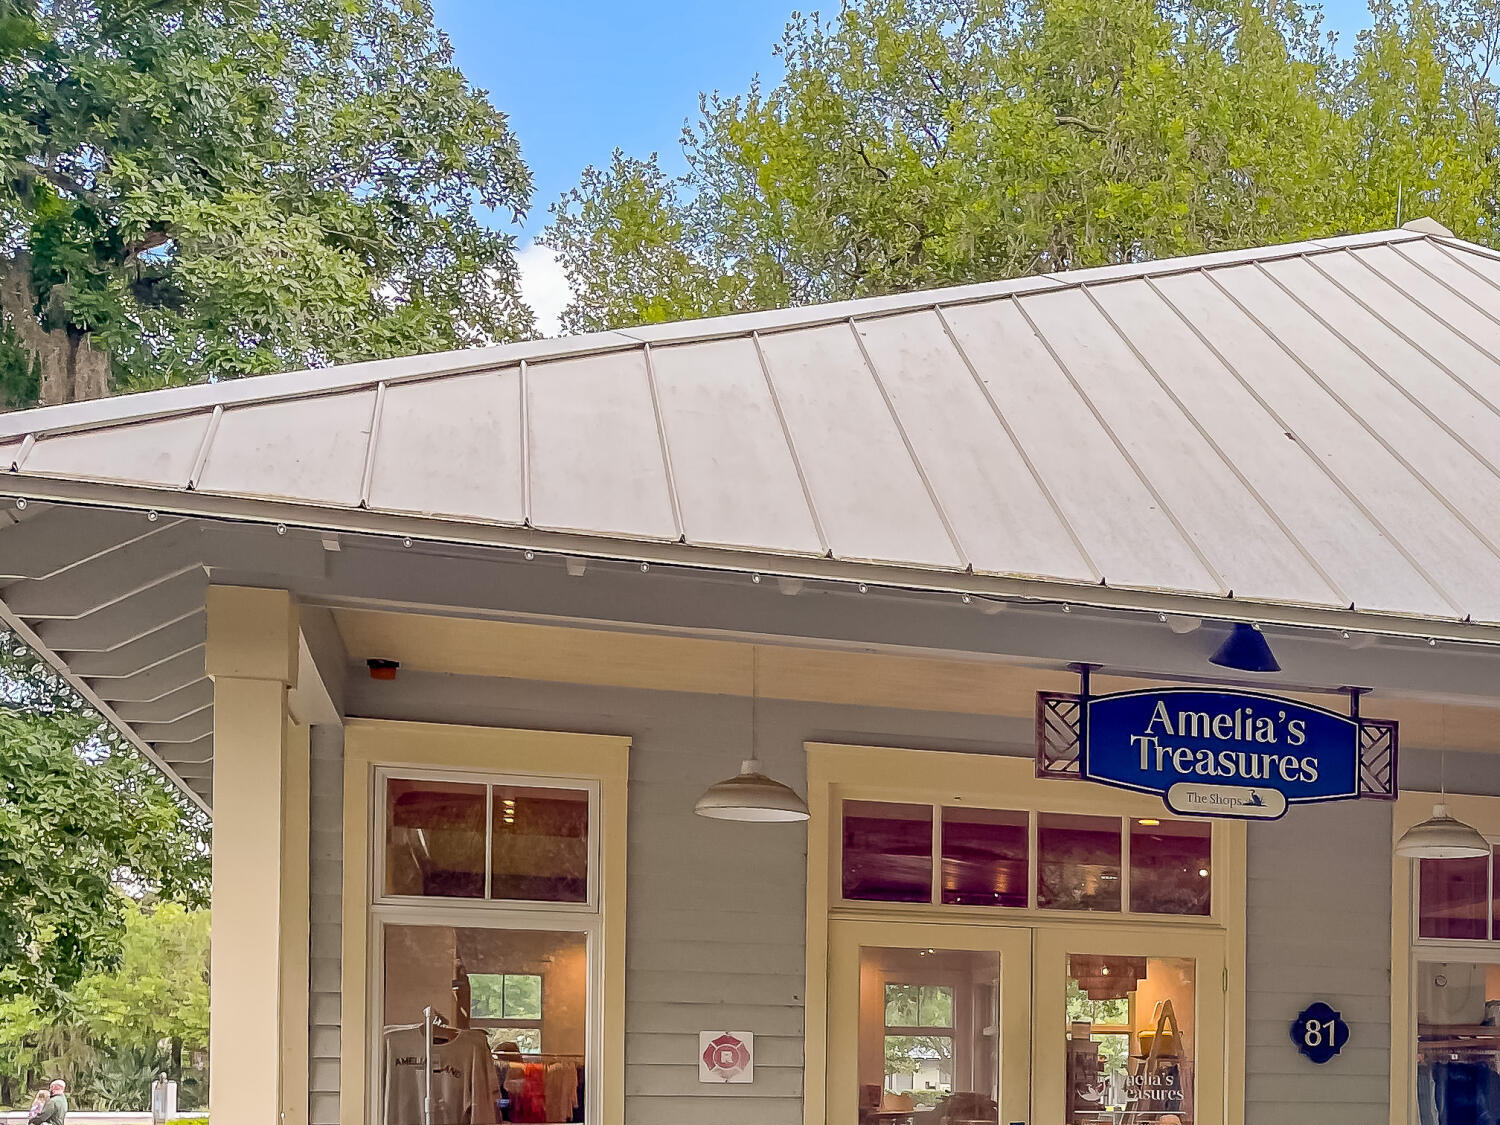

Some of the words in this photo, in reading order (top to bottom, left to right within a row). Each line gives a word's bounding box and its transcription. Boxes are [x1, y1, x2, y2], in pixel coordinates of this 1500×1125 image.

[1144, 700, 1306, 746] Amelia's
[1130, 734, 1319, 783] Treasures
[1186, 792, 1208, 804] The
[1209, 793, 1243, 808] Shops
[1304, 1019, 1335, 1047] 81
[1121, 1088, 1185, 1101] reasures
